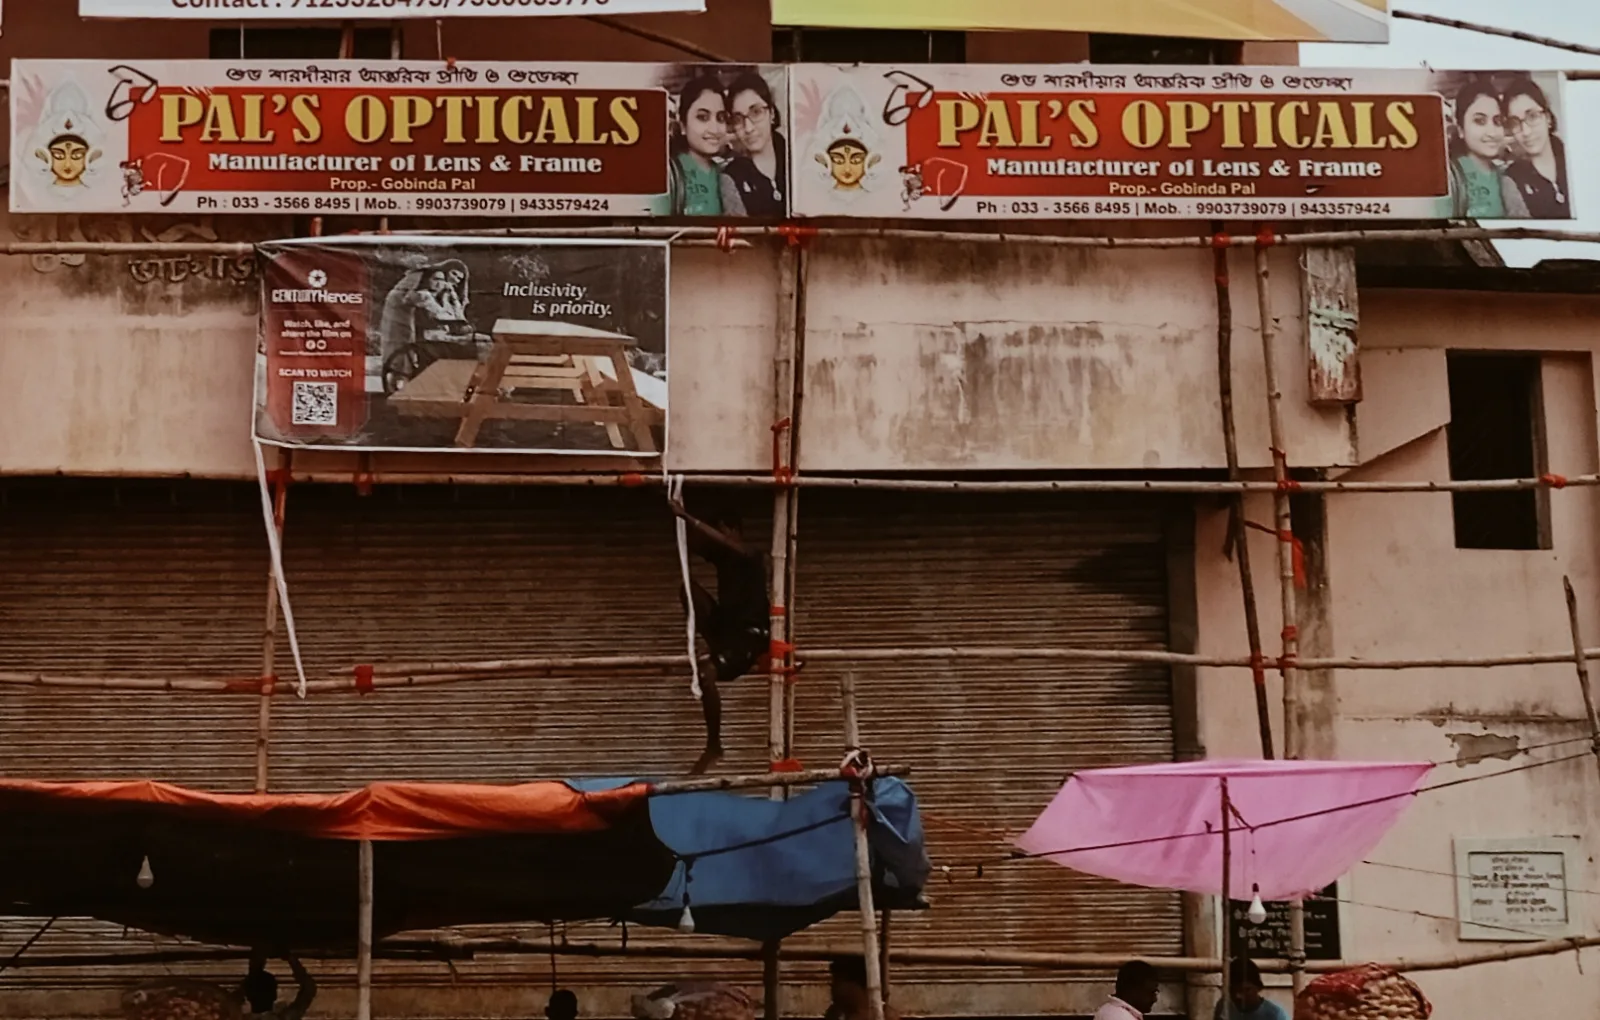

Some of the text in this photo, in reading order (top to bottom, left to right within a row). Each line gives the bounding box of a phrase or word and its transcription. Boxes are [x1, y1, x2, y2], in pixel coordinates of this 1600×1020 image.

[226, 68, 262, 81] শুভ
[485, 69, 500, 83] ও
[1000, 74, 1037, 87] শুভ
[1261, 75, 1275, 89] ও
[158, 93, 641, 145] PAL'S OPTICALS
[936, 99, 1419, 150] PAL'S OPTICALS
[208, 152, 602, 173] Manufacturer of Lens & Frame
[986, 158, 1382, 177] Manufacturer of Lens & Frame
[381, 177, 447, 190] Gobinda
[451, 178, 476, 190] Pal
[1160, 182, 1227, 195] Gobinda
[1230, 183, 1256, 195] Pal
[197, 196, 218, 209] Ph
[232, 197, 259, 209] 033
[273, 197, 310, 209] 3566
[314, 197, 351, 210] 8495
[364, 198, 401, 210] Mob.
[415, 198, 506, 211] 9903739079
[519, 199, 609, 212] 9433579424
[976, 201, 997, 214] Ph
[1011, 202, 1039, 214] 033
[1053, 202, 1090, 214] 3566
[1094, 202, 1131, 214] 8495
[1144, 203, 1182, 214] Mob.
[1196, 203, 1287, 215] 9903739079
[1300, 203, 1391, 215] 9433579424
[503, 281, 587, 300] Inclusivity
[532, 300, 612, 318] is priority.
[333, 319, 351, 329] and
[281, 330, 305, 338] share
[306, 330, 321, 338] the
[322, 329, 340, 338] film
[278, 367, 352, 378] SCAN TO WATCH
